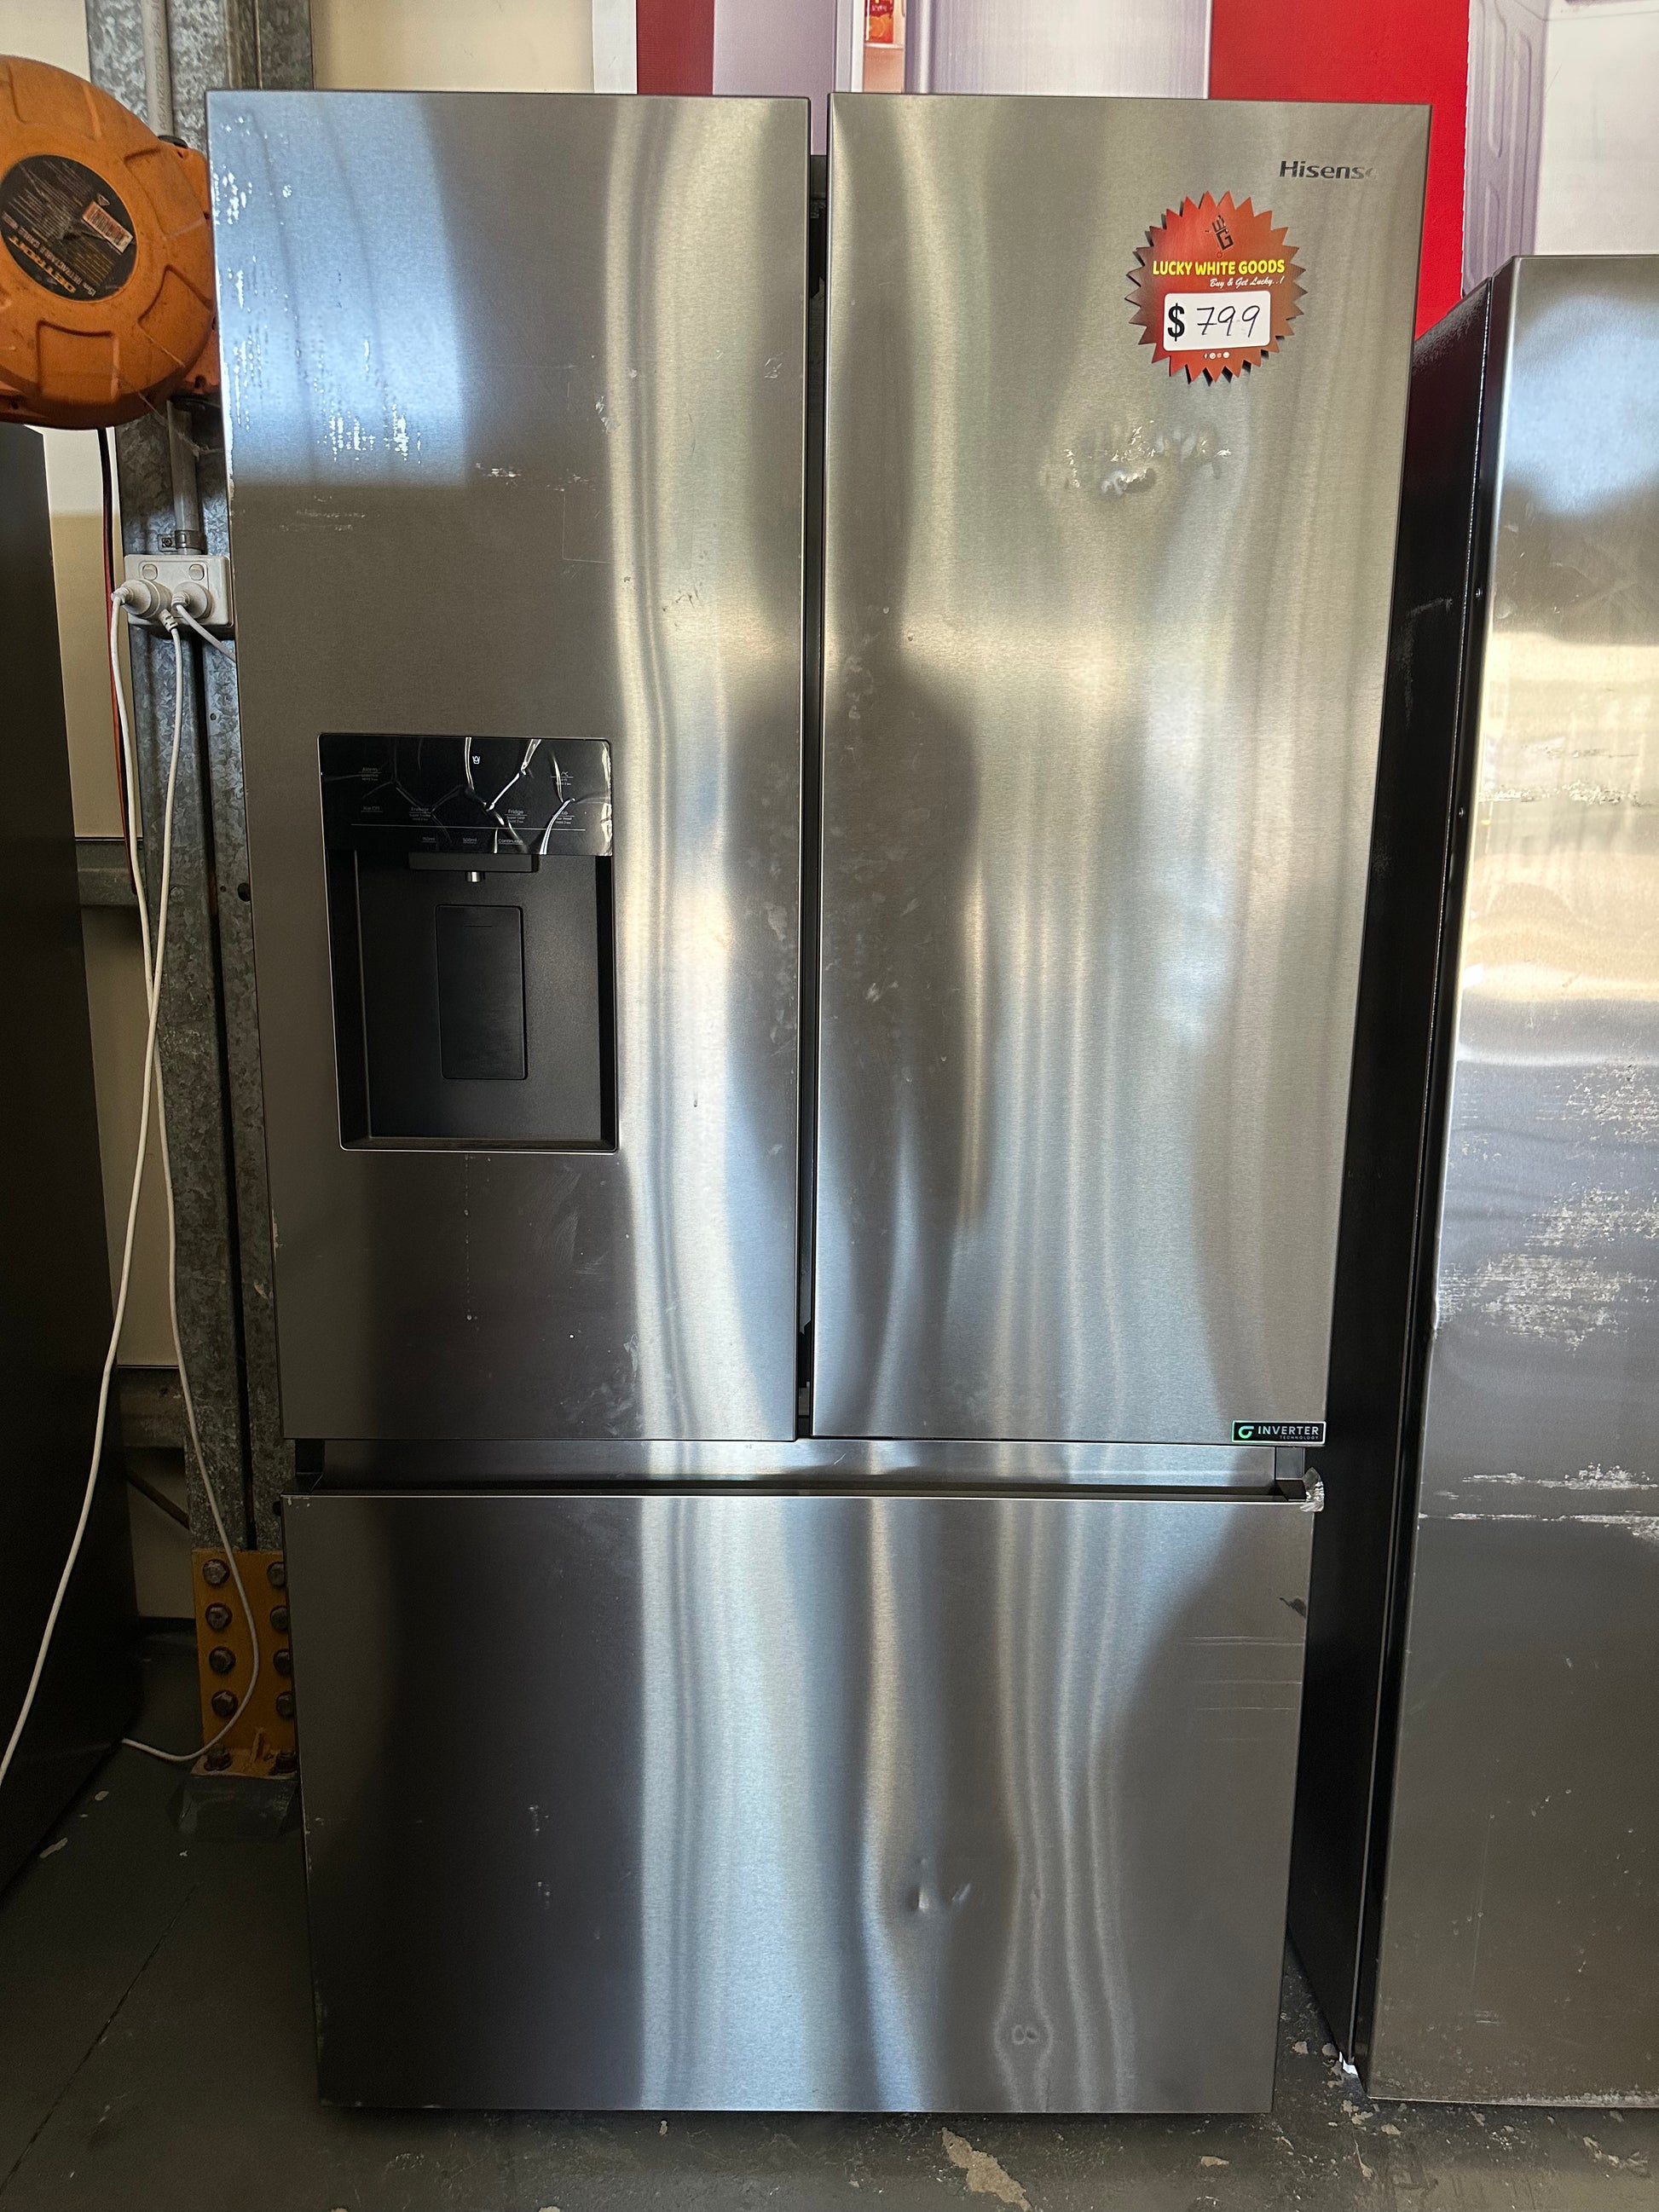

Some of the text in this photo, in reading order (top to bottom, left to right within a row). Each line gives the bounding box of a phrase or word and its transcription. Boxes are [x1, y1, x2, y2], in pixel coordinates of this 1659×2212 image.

[1153, 259, 1286, 275] LUCKY WHITE GOODS
[1210, 278, 1225, 288] Buy
[1227, 277, 1234, 286] &
[1235, 278, 1249, 289] Get
[1257, 1425, 1320, 1435] INVERTER
